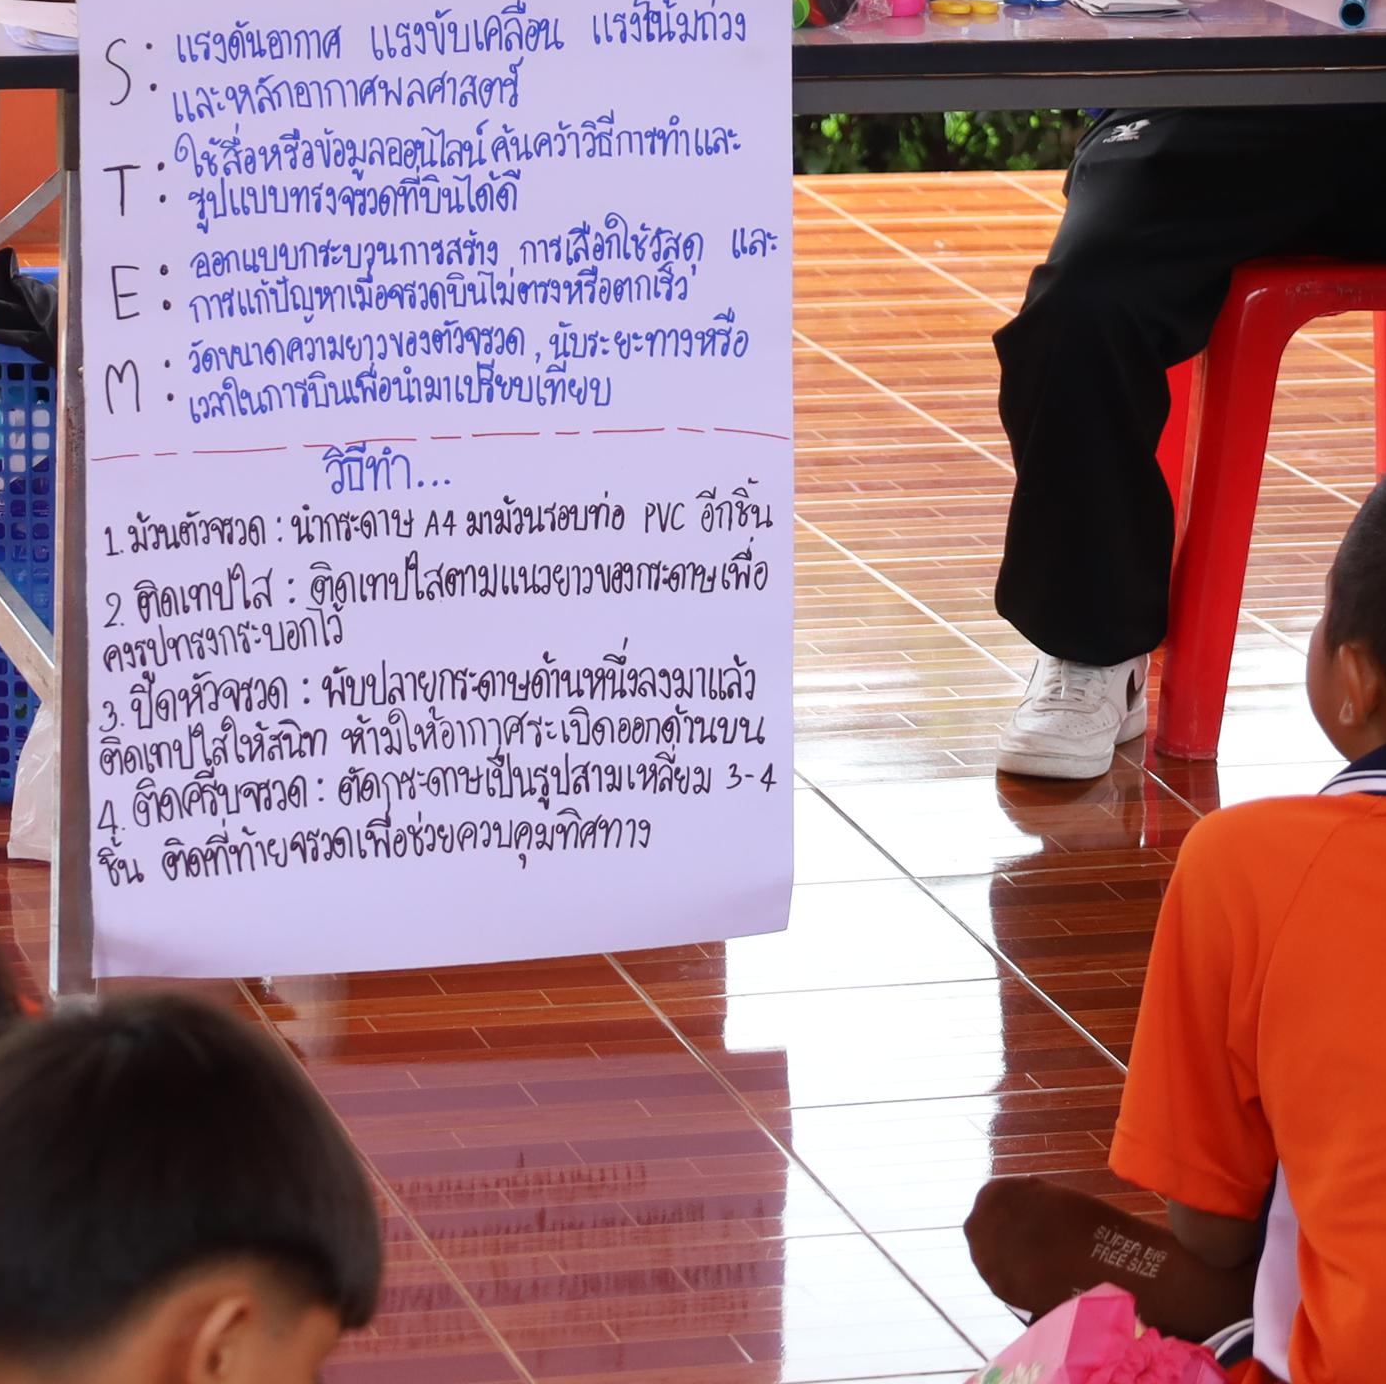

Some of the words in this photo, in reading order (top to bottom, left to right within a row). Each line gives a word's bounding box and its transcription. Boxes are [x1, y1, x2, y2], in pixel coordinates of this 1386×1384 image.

[176, 20, 342, 64] แรงดันอากาศ
[189, 229, 499, 279] ออกแบบกระบวนการสร้าง
[518, 212, 705, 276] การเลือกใช้วัสดุ
[731, 227, 779, 260] และ
[549, 307, 750, 359] นับระยะทางหรือ
[128, 511, 265, 553] ม้วนตัวจรวด
[291, 504, 415, 545] นำกระดาษ
[424, 509, 458, 538] A4
[643, 501, 686, 534] PVC
[695, 477, 774, 534] อีกชิ้น
[133, 562, 273, 624] ติดเทปใส
[725, 762, 778, 793] 3-4
[97, 834, 145, 887] ชิ้น
[1091, 1242, 1128, 1268] FREE
[1126, 1257, 1161, 1279] SIZE
[1094, 1225, 1142, 1256] SUPER
